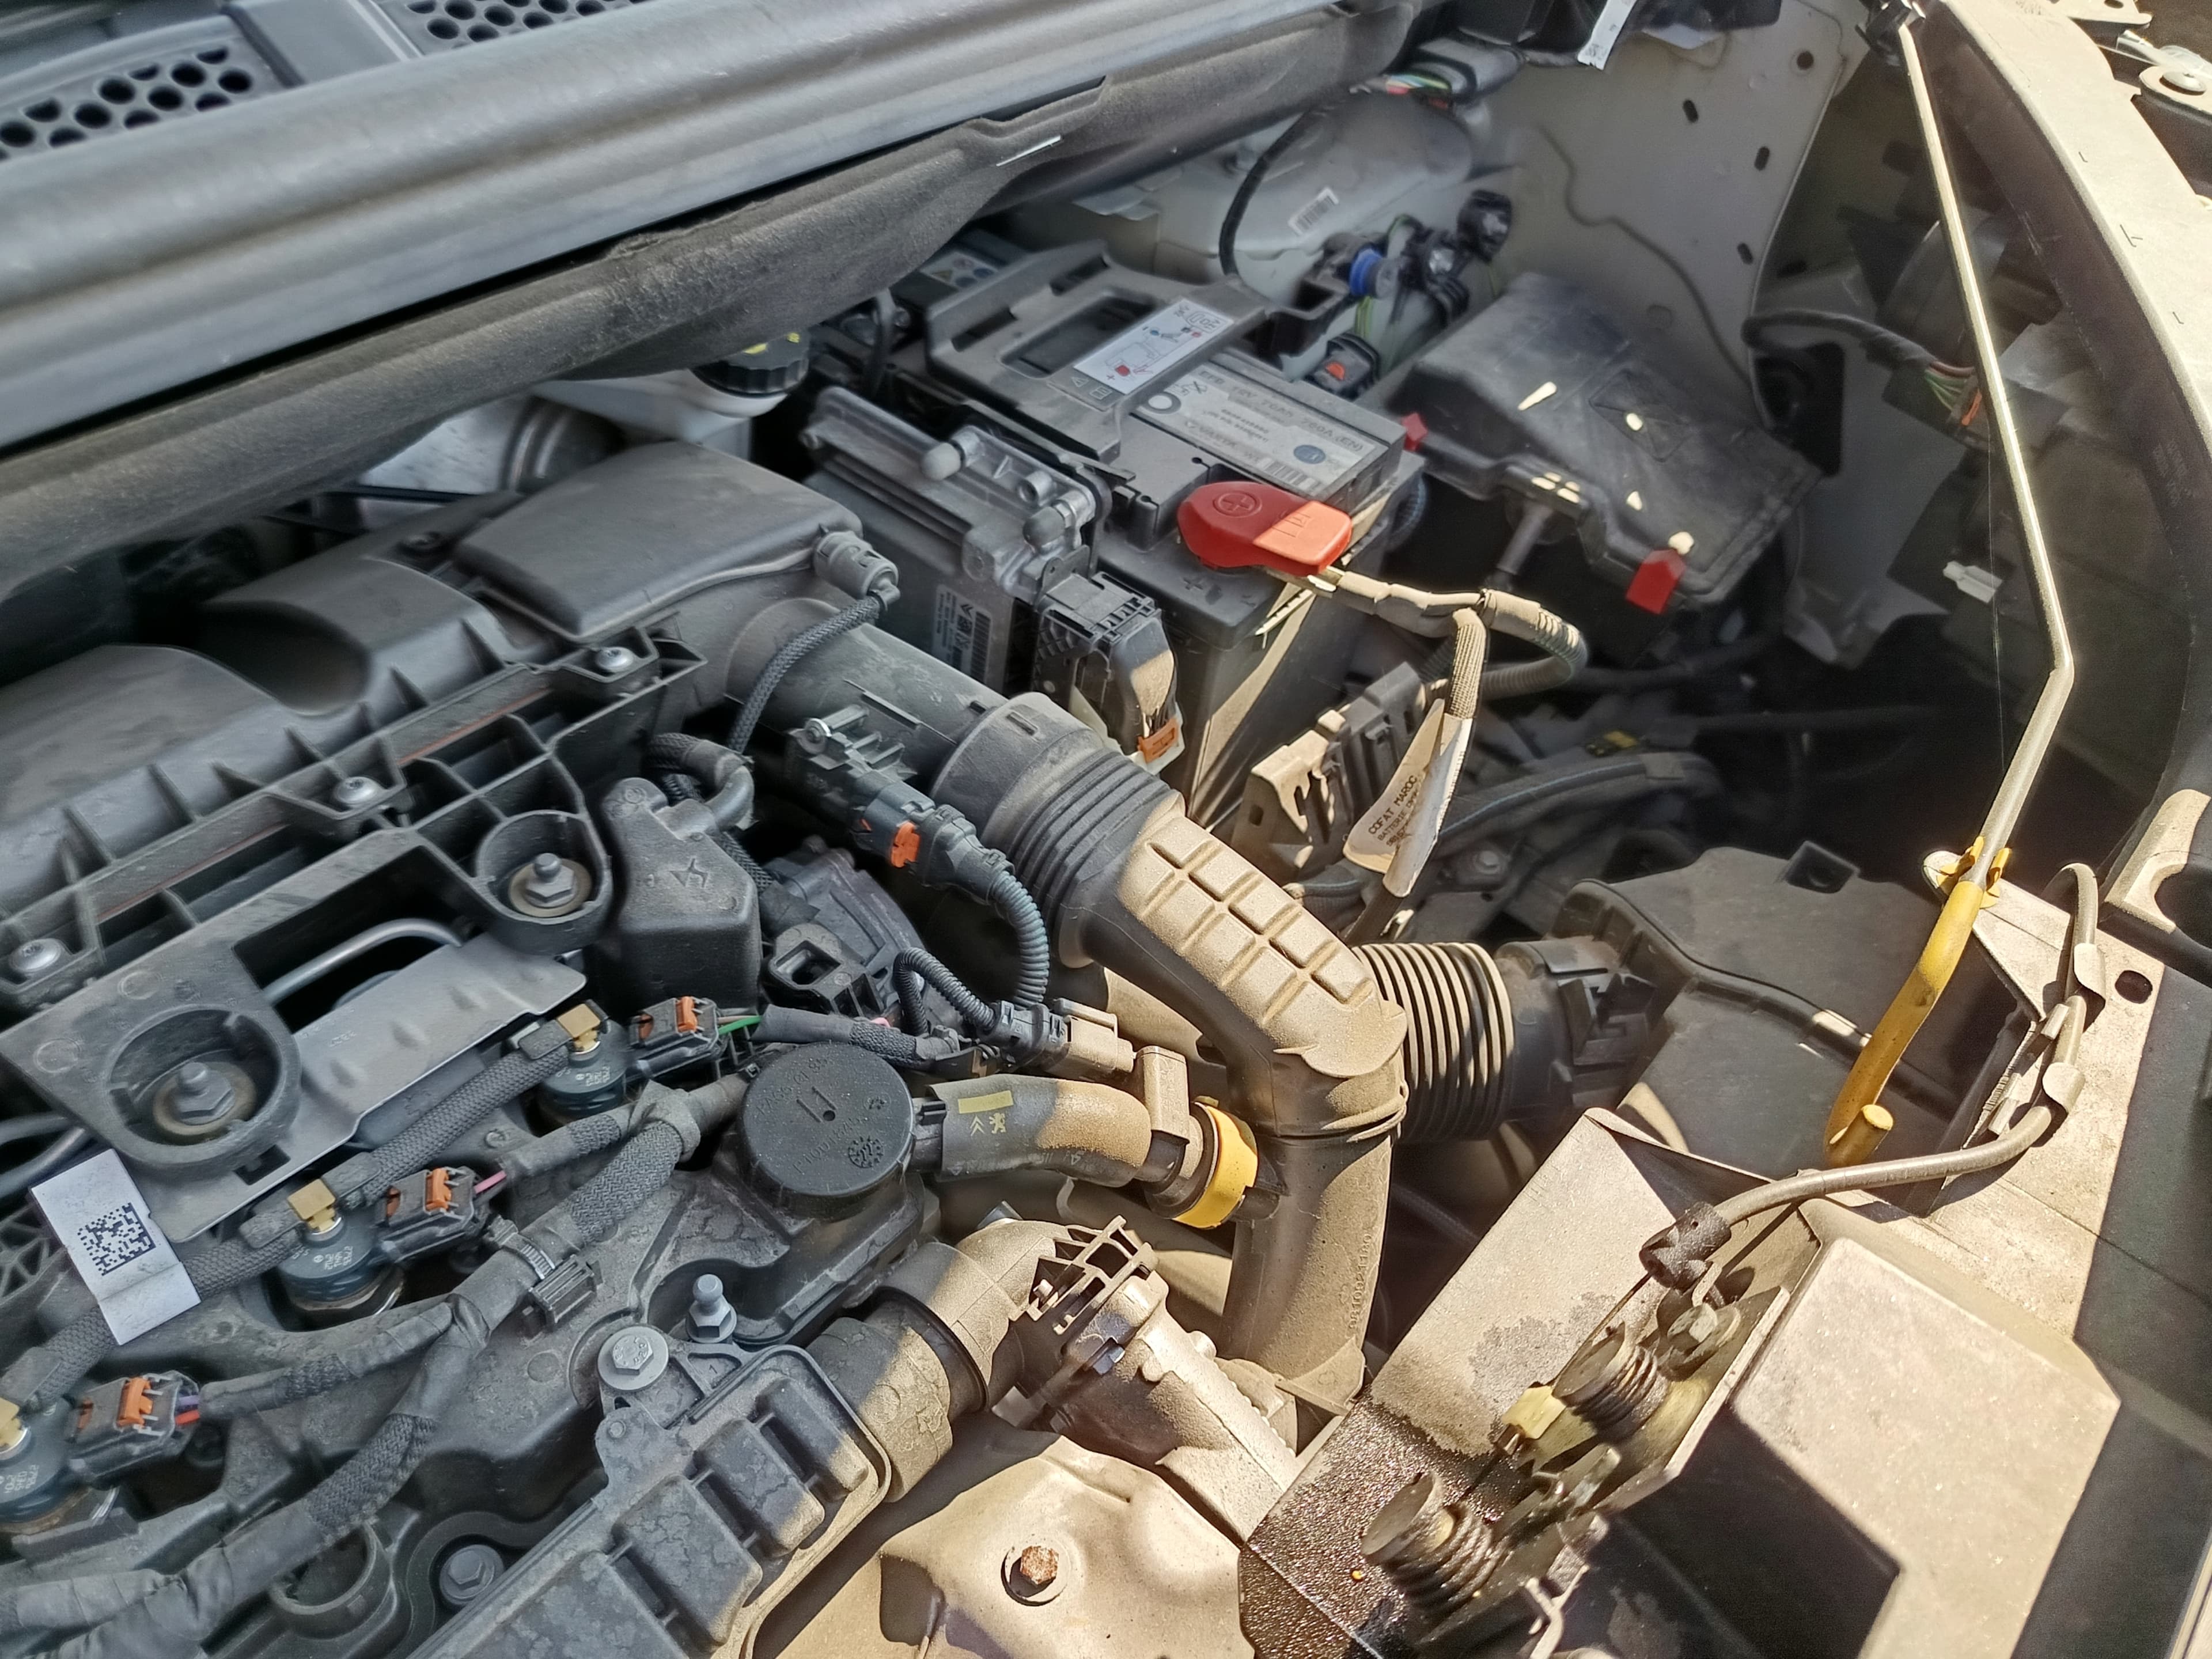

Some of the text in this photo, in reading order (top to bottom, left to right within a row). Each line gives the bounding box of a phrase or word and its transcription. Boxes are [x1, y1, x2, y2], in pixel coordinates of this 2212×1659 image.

[1368, 775, 1418, 835] COFAT MAROC
[1377, 809, 1407, 841] BATTERIE
